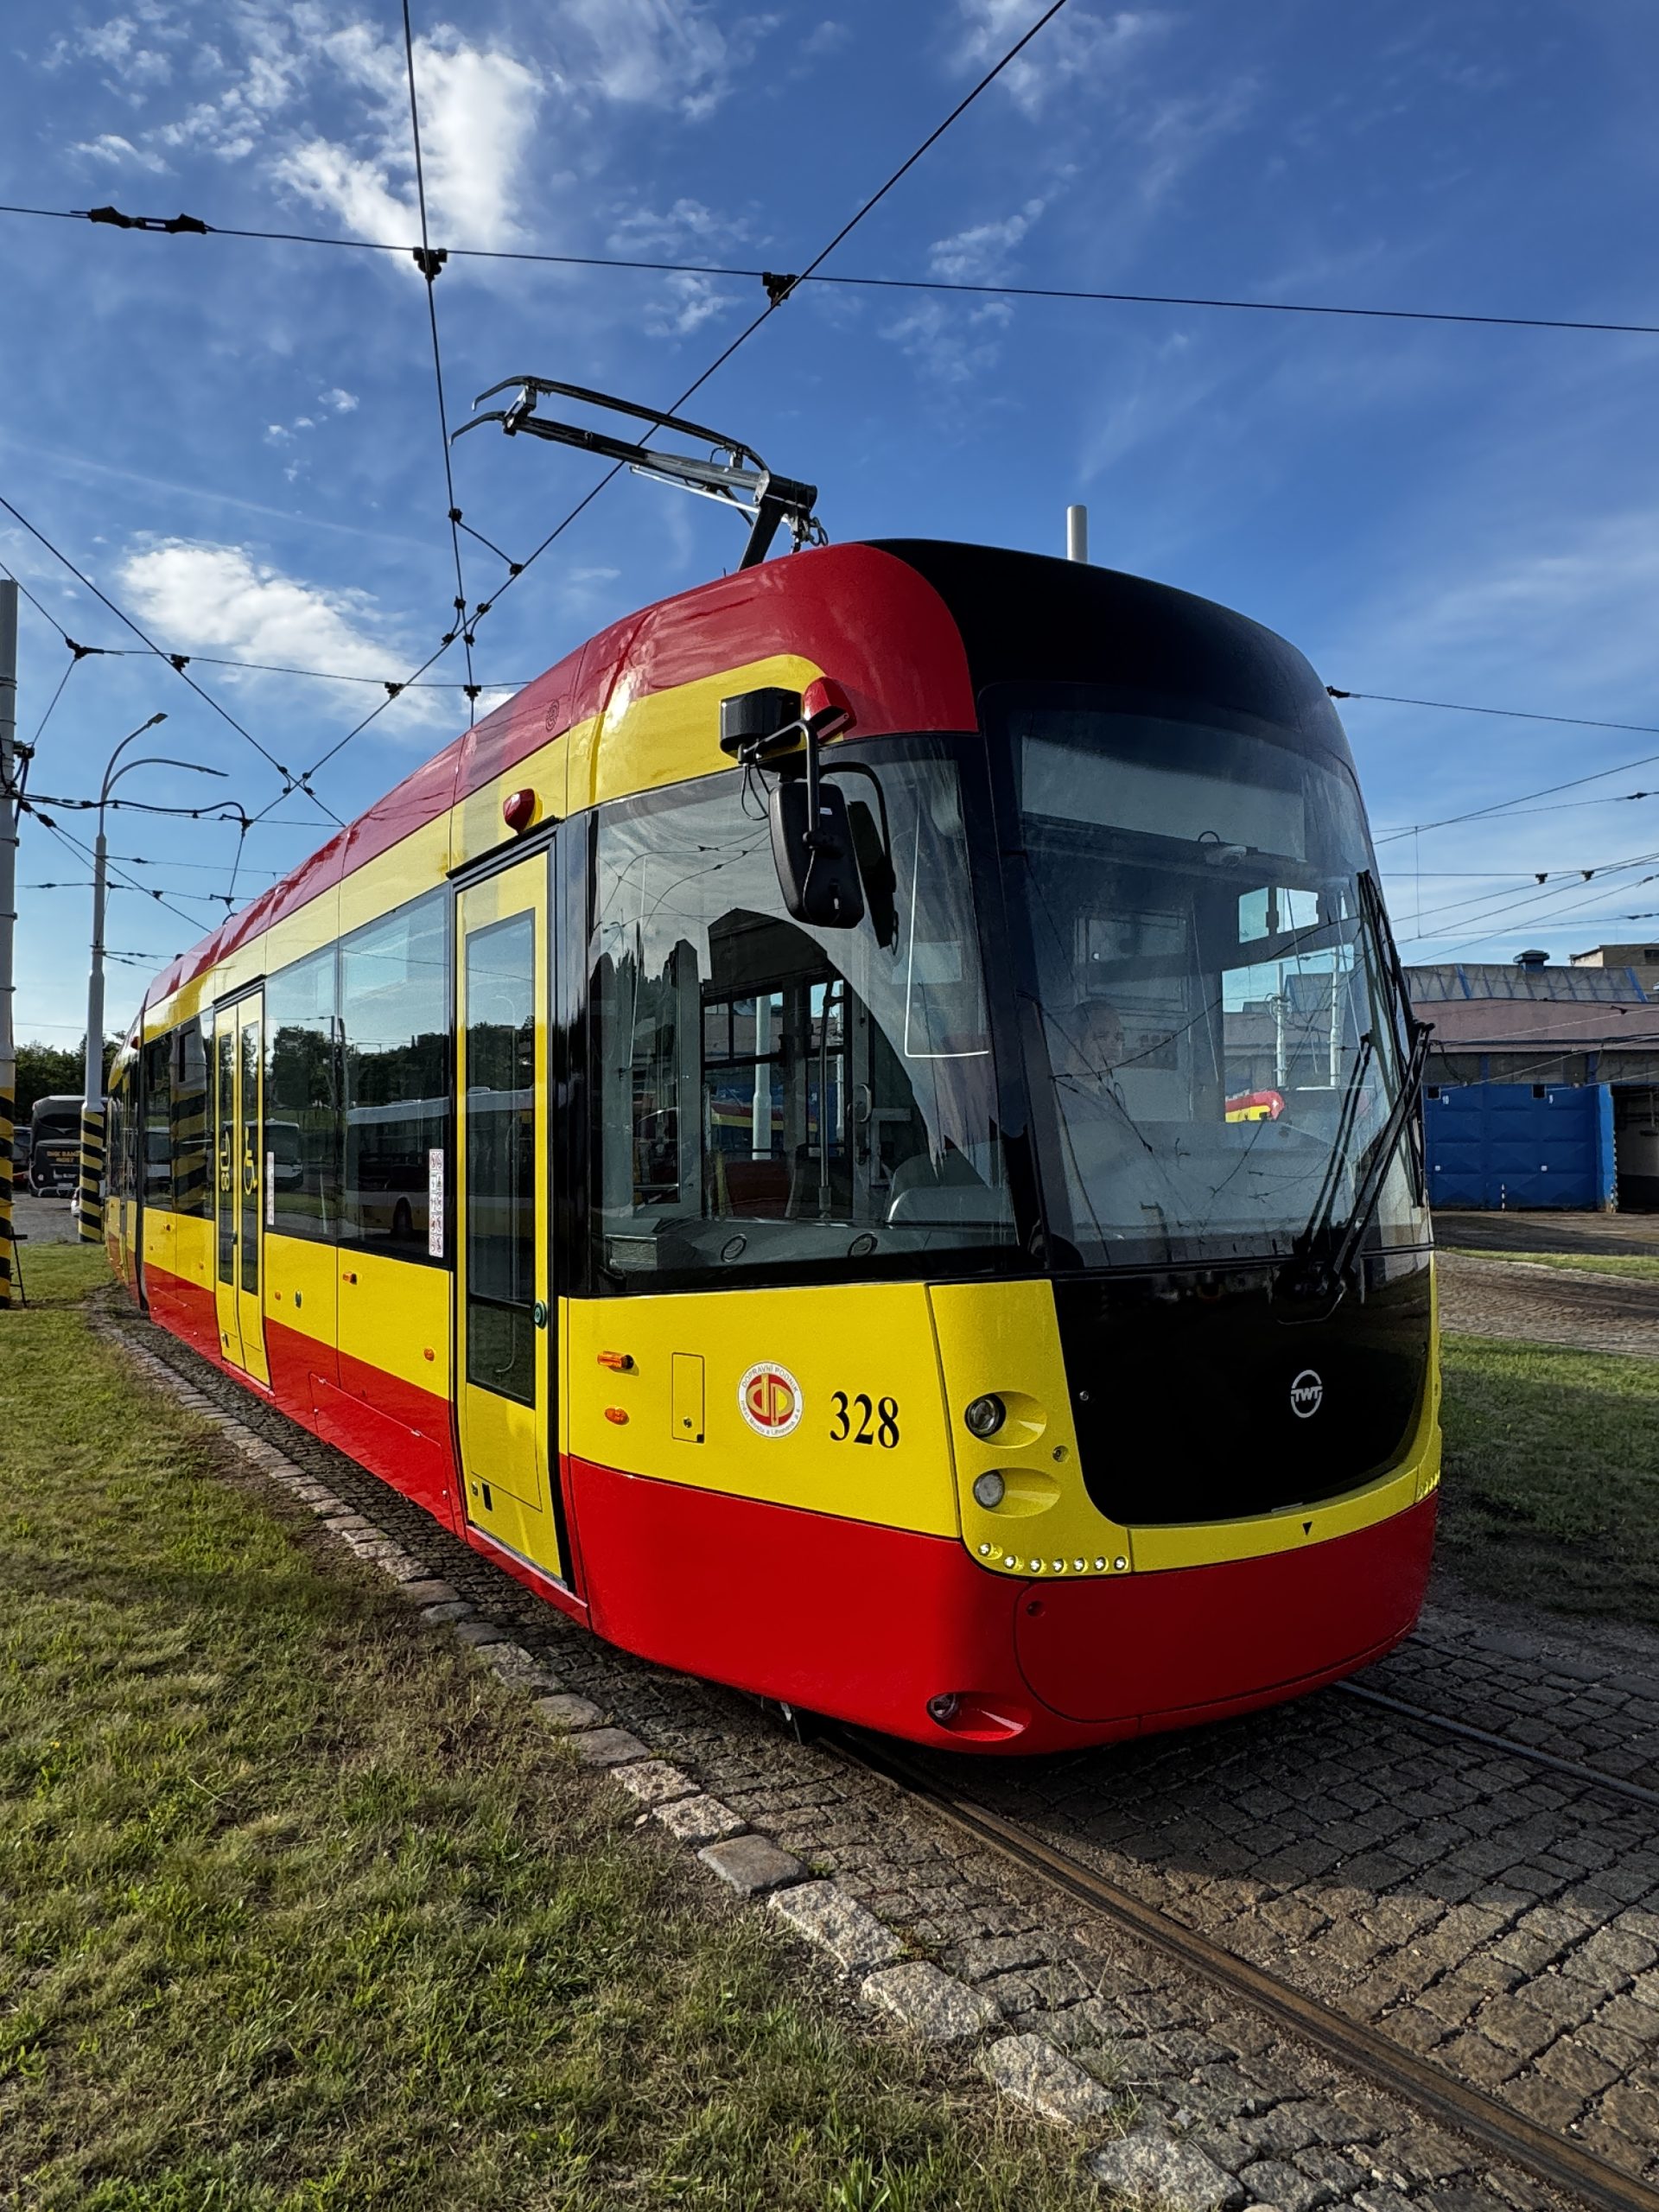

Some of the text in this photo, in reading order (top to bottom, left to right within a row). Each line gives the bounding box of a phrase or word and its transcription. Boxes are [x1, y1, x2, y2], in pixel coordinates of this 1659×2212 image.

[1442, 1095, 1450, 1105] 10
[774, 1366, 798, 1393] PODNIK
[1291, 1386, 1323, 1402] TWT
[830, 1390, 900, 1449] 328
